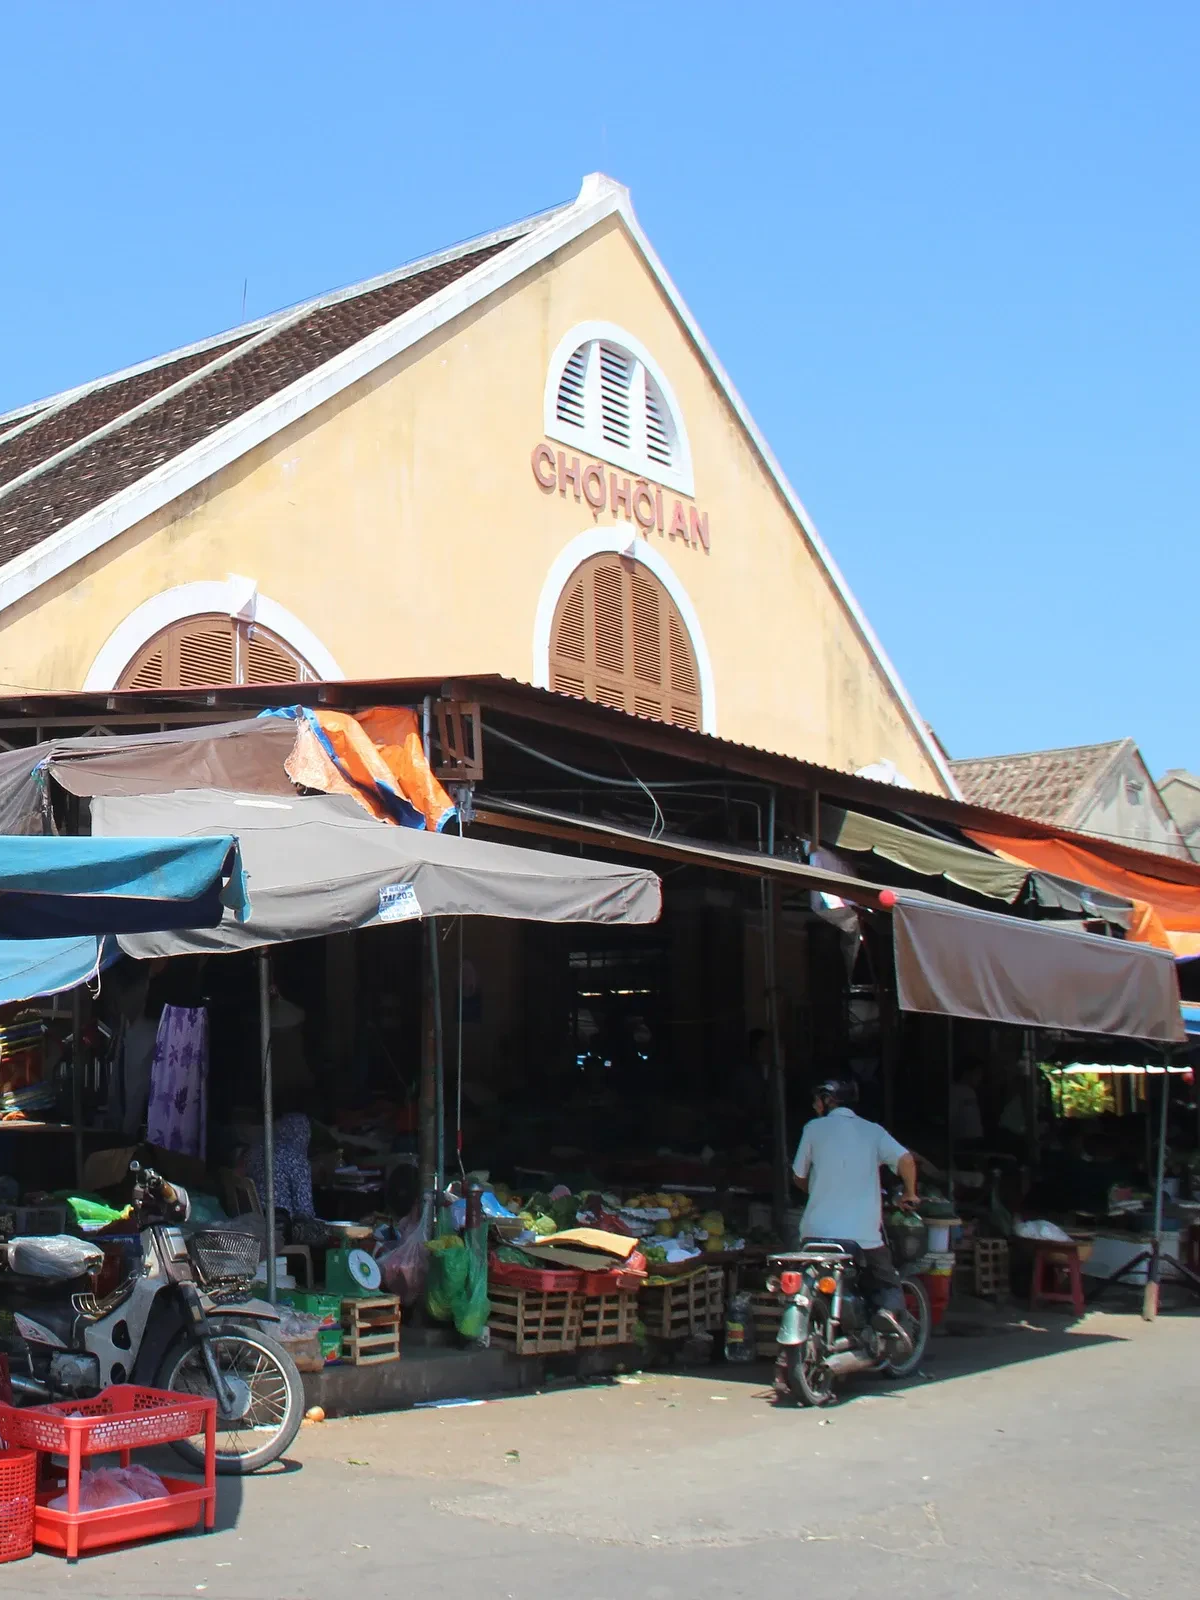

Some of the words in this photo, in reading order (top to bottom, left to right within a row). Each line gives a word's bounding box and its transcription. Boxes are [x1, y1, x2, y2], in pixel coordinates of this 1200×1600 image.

[531, 443, 607, 523] CHỢ
[609, 473, 664, 541] HỘI
[668, 500, 711, 555] AN
